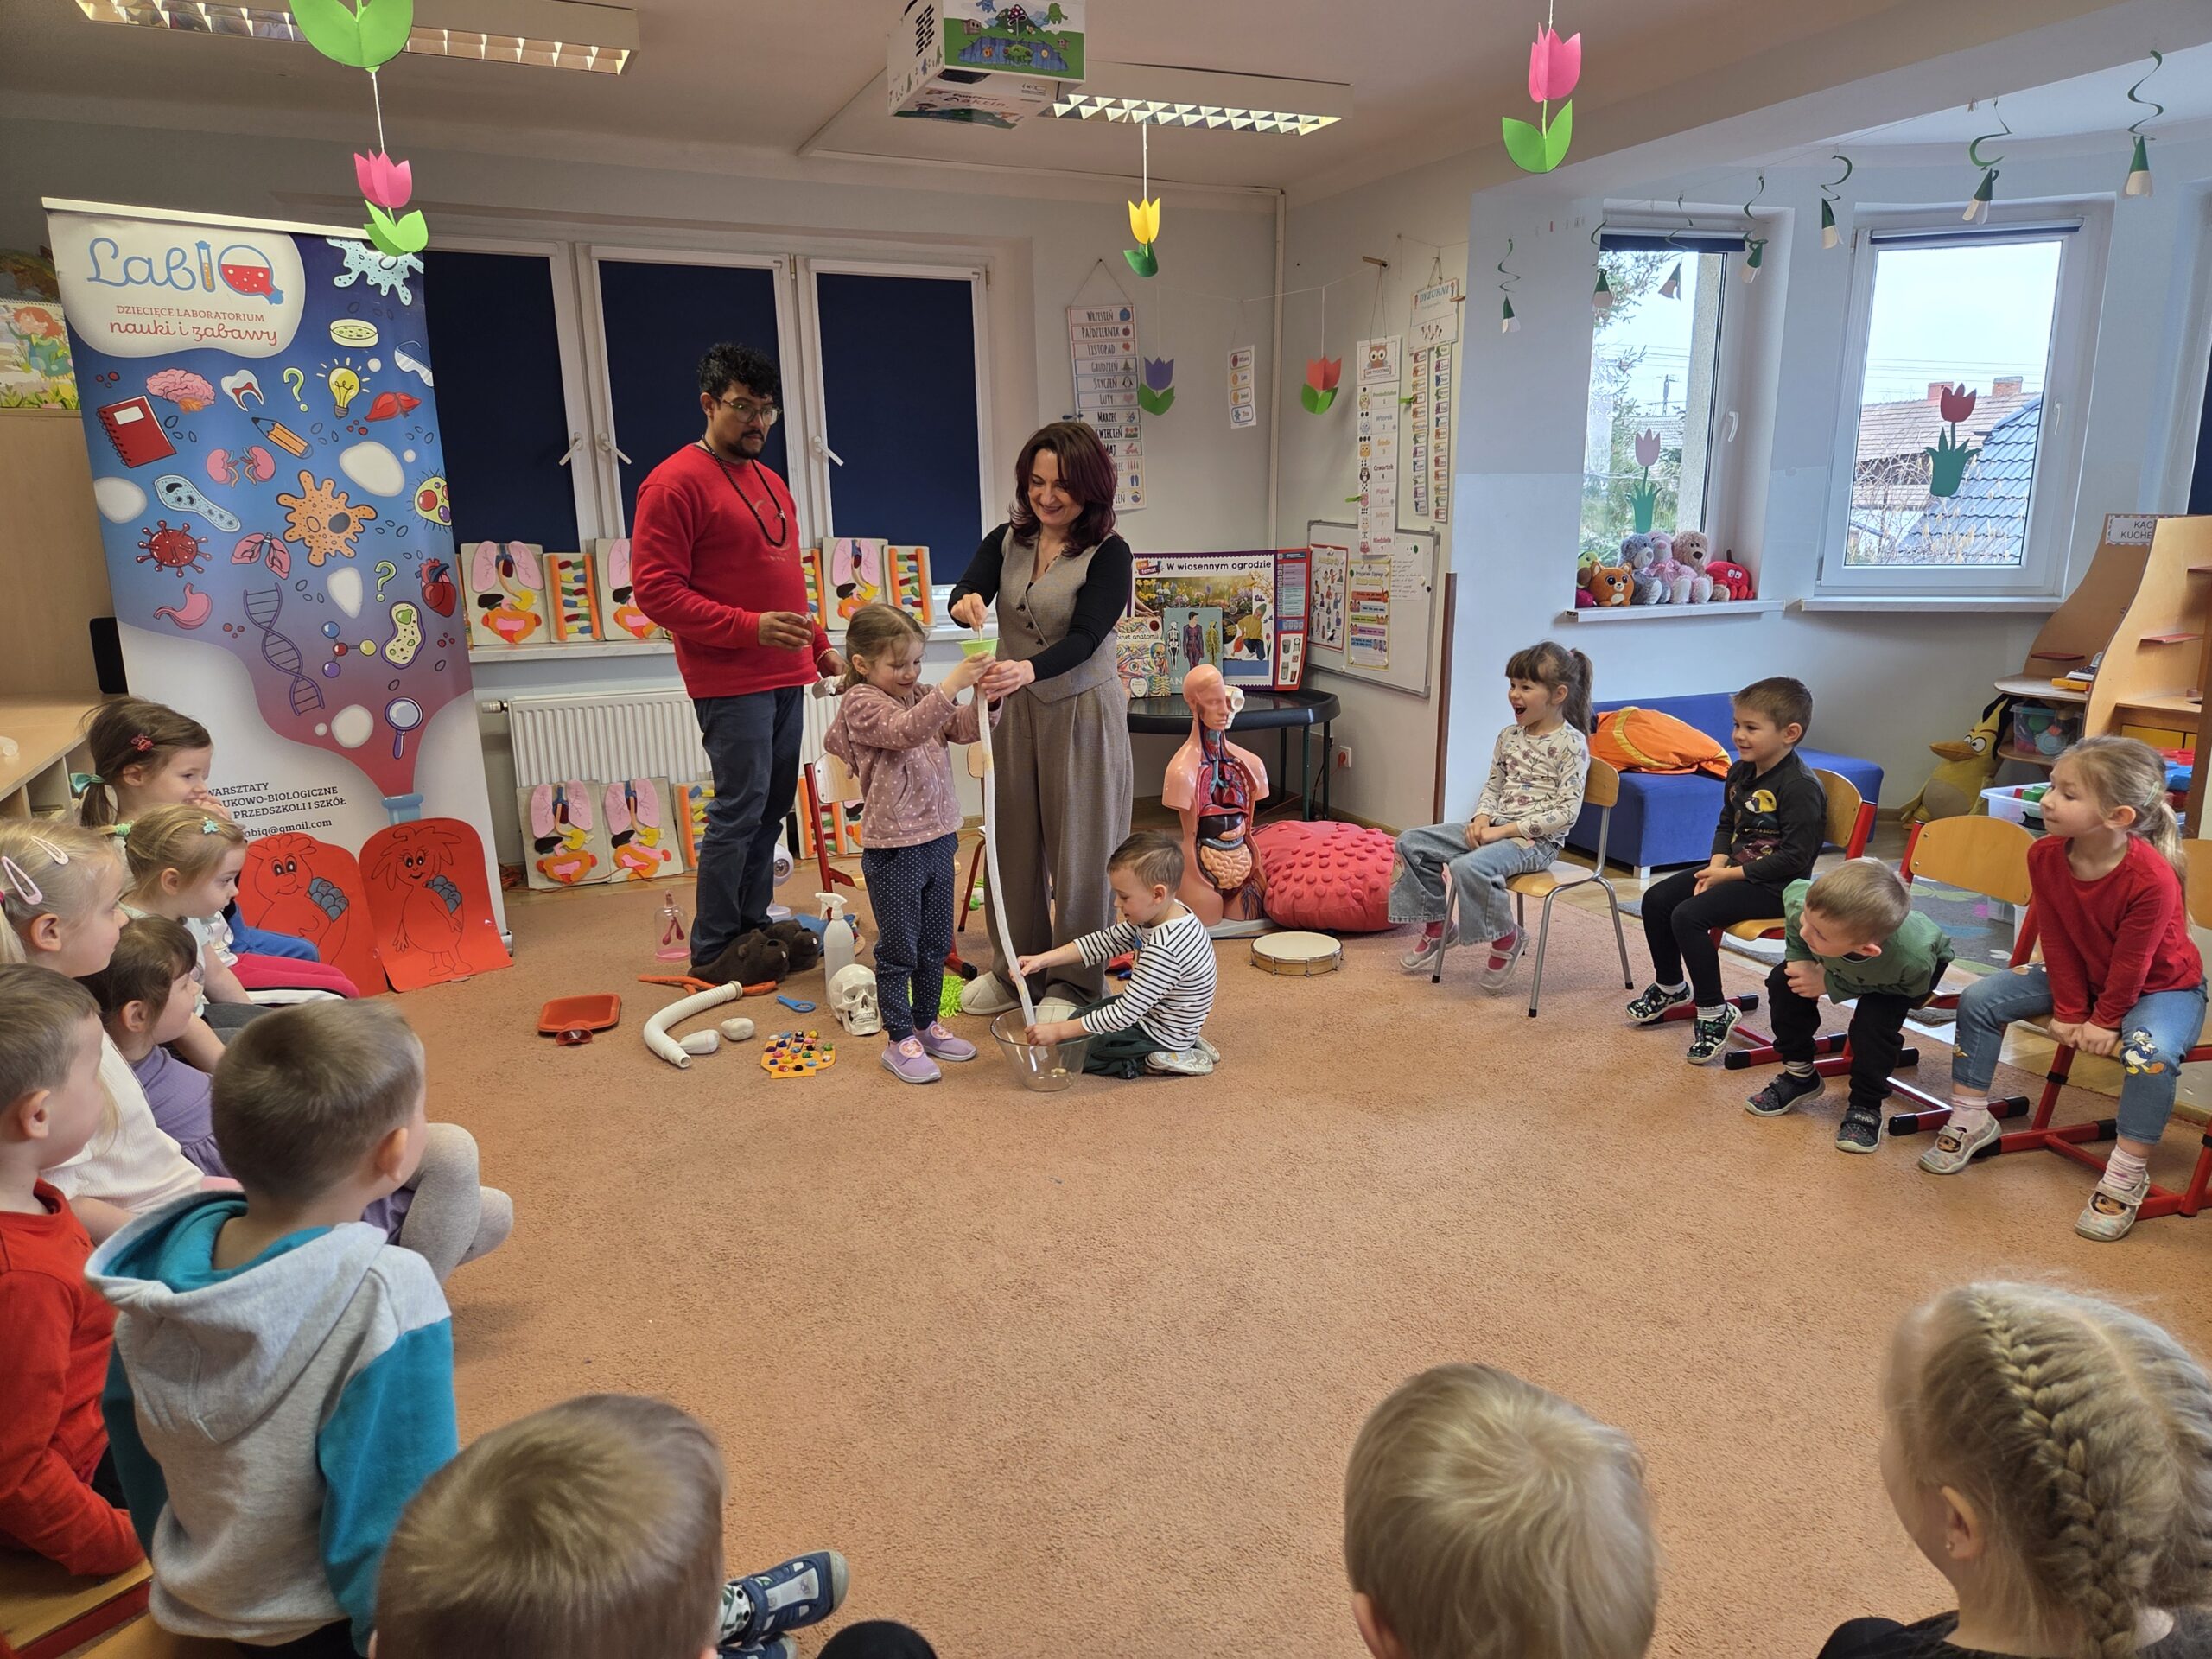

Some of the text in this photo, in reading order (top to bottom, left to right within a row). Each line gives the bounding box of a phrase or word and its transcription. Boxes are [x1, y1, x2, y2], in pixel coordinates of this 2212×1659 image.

[116, 305, 264, 322] DZIECIĘCE LABORATORIUM
[1086, 309, 1114, 322] WRZESIEŃ
[110, 320, 278, 346] nauki i zabawy
[1081, 326, 1121, 339] PAŹDZIERNIK
[1087, 344, 1116, 356] LISTOPAD
[1091, 360, 1118, 373] GRUDZIEŃ
[1093, 376, 1117, 389] STYCZEŃ
[1099, 394, 1113, 405] LUTY
[1097, 412, 1117, 423] MARZEC
[2133, 521, 2153, 531] KĄC
[2120, 531, 2152, 539] KUCHE
[1166, 560, 1272, 572] W wiosennym ogrodzie
[207, 782, 269, 797] WARSZTATY
[222, 786, 338, 808] UKOWO-BIOLOGICZNE
[233, 801, 306, 819] PRZEDSZKOLI
[314, 797, 347, 810] SZKÓŁ
[245, 819, 333, 838] abiq@gmail.com
